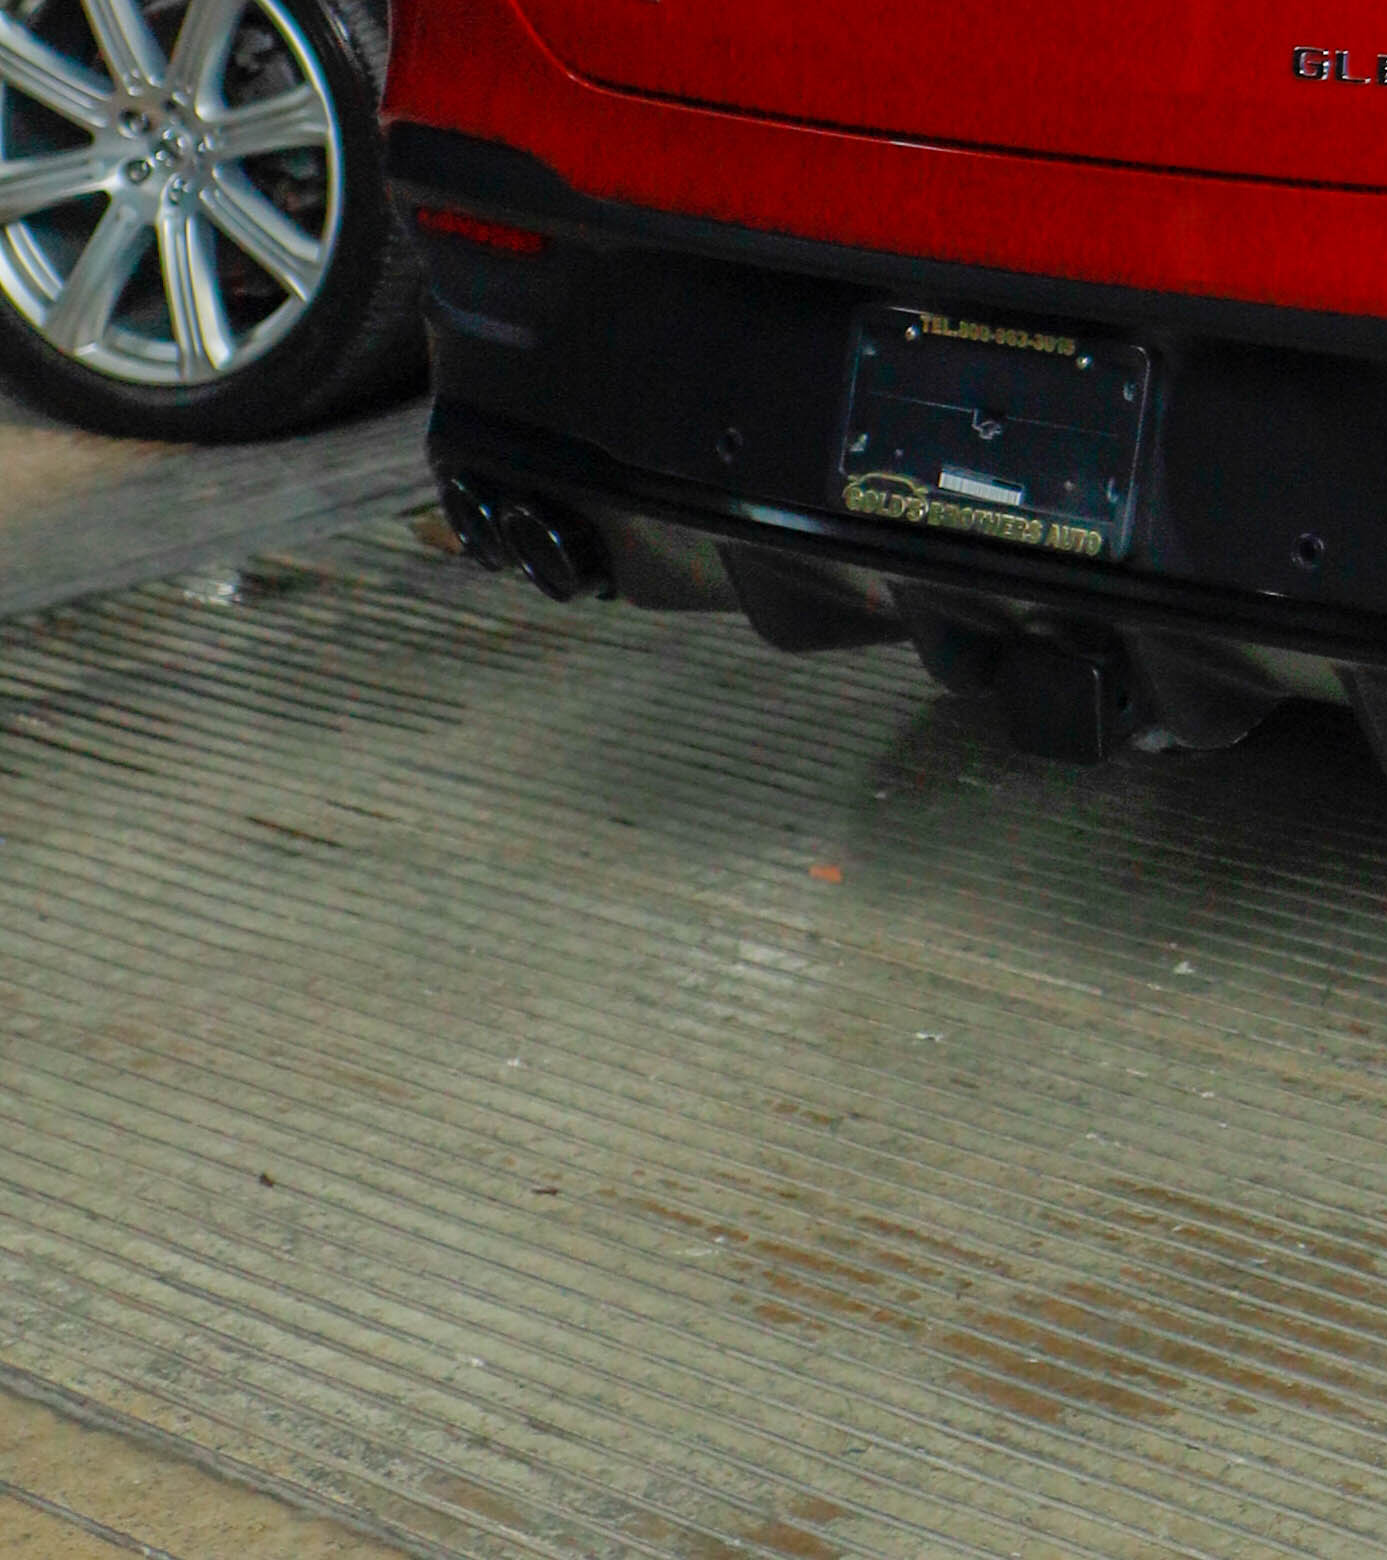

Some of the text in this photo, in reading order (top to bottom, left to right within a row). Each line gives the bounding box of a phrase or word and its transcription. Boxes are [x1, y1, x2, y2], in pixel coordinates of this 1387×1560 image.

[843, 485, 1102, 557] GOLD'S BROTHERS AUTO
